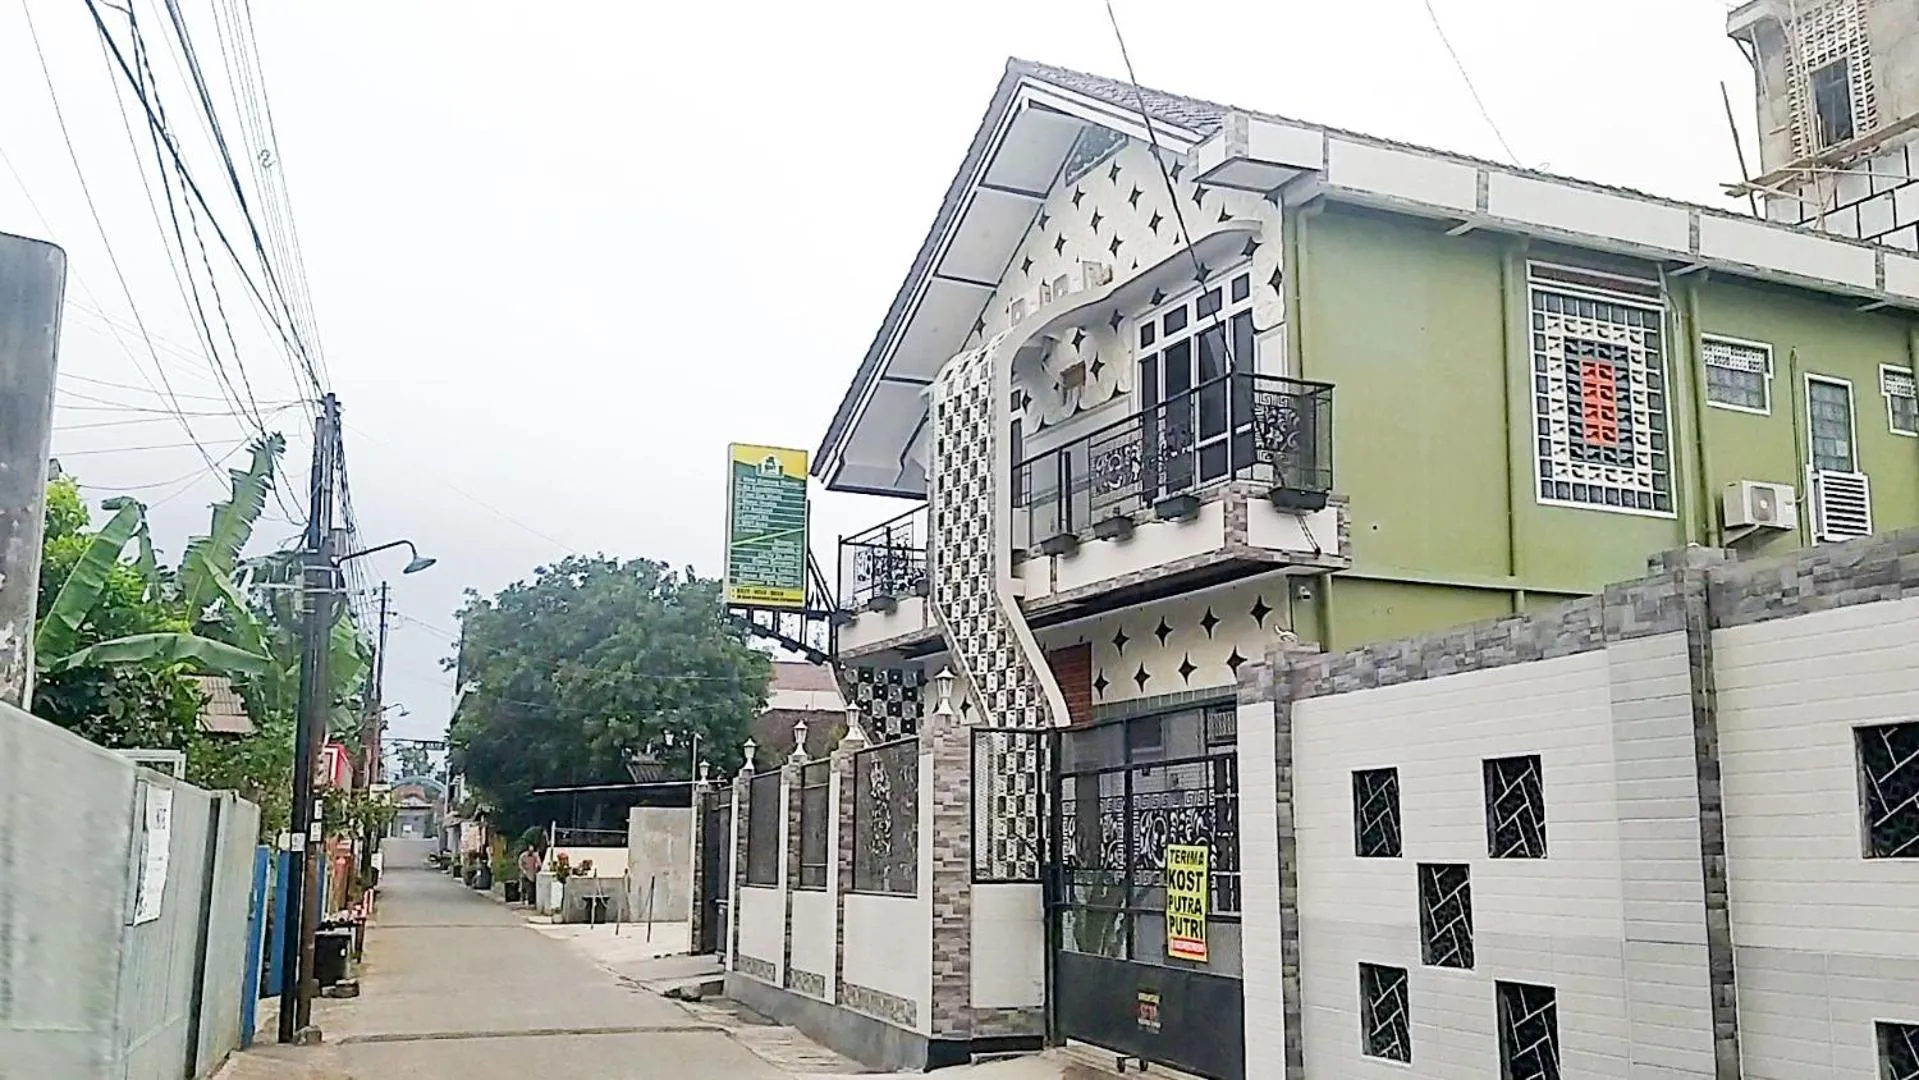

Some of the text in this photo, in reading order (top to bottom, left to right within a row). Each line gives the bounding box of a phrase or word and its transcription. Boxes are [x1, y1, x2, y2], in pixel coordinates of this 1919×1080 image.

[1170, 849, 1204, 866] TERIMA
[1168, 869, 1204, 892] KOST
[1168, 894, 1202, 916] PUTRA
[1169, 915, 1203, 939] PUTRI
